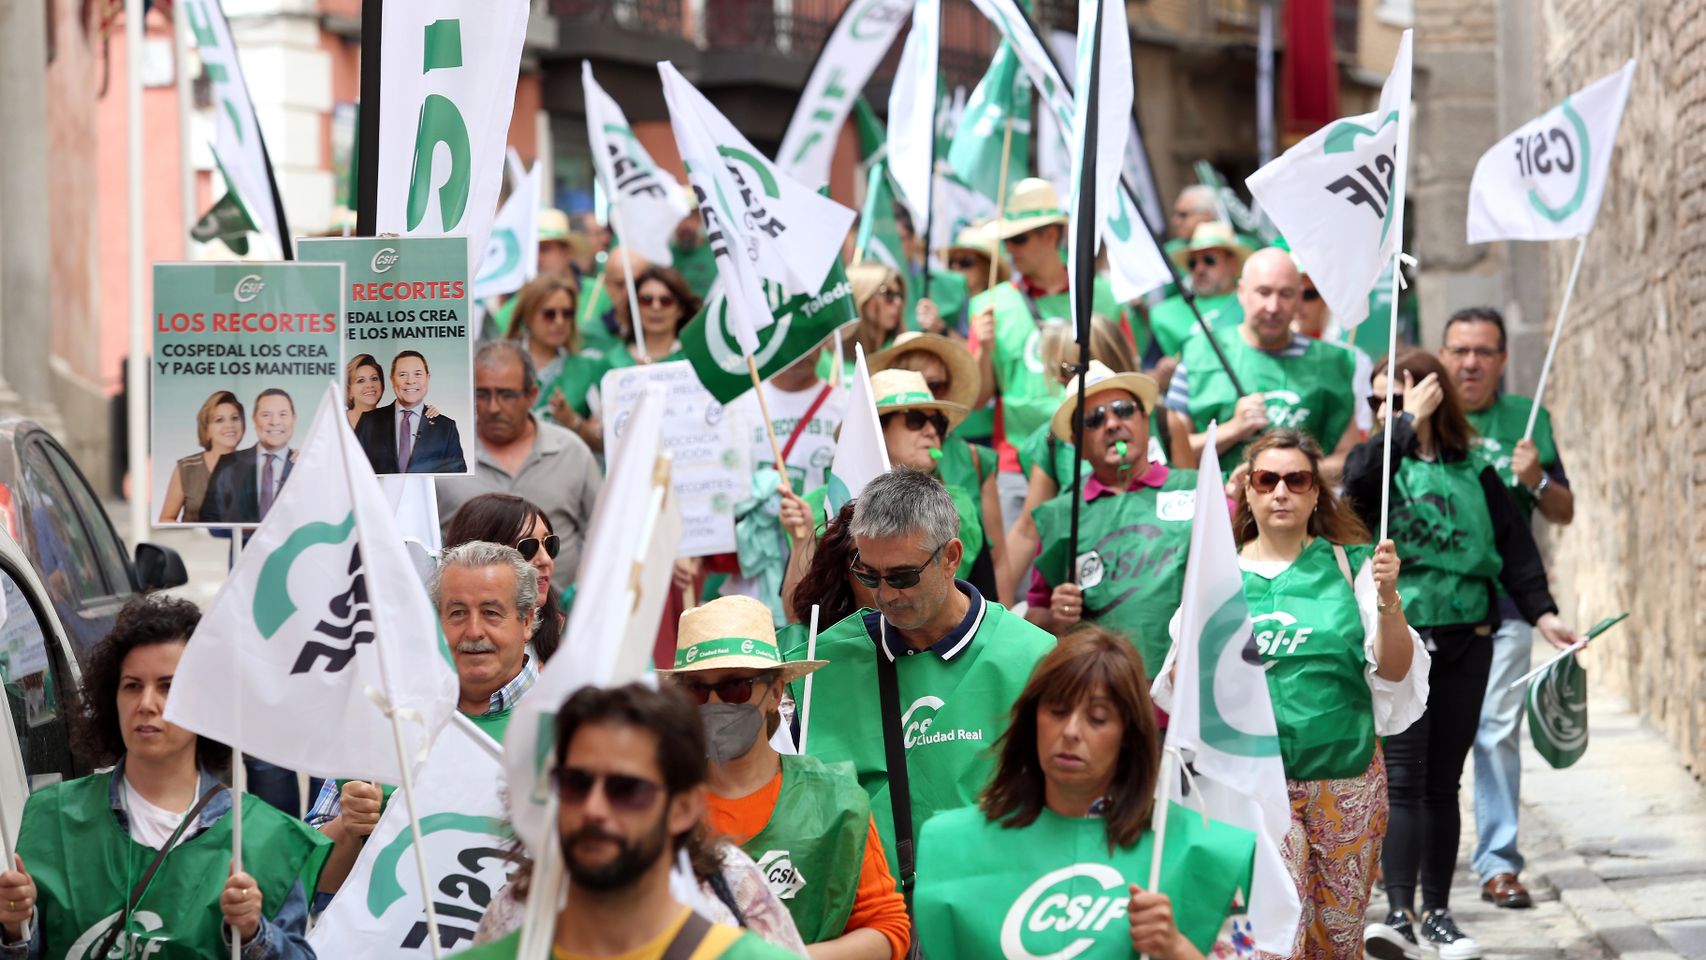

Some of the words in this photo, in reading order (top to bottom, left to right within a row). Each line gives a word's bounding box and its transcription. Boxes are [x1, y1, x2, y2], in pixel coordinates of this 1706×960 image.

[377, 255, 399, 265] CSIF
[352, 281, 465, 301] RECORTES
[158, 313, 206, 333] LOS
[212, 313, 337, 333] RECORTES
[387, 310, 416, 323] LOS
[419, 310, 458, 322] CREA
[360, 327, 388, 340] LOS
[392, 325, 465, 339] MANTIENE
[162, 344, 246, 358] COSPEDAL
[251, 344, 282, 358] LOS
[286, 344, 328, 358] CREA
[157, 362, 169, 375] Y
[173, 362, 216, 375] PAGE
[220, 362, 251, 375] LOS
[255, 362, 336, 376] MANTIENE
[916, 731, 955, 746] Ciudad
[957, 728, 983, 741] Real
[1028, 893, 1130, 932] CSIF
